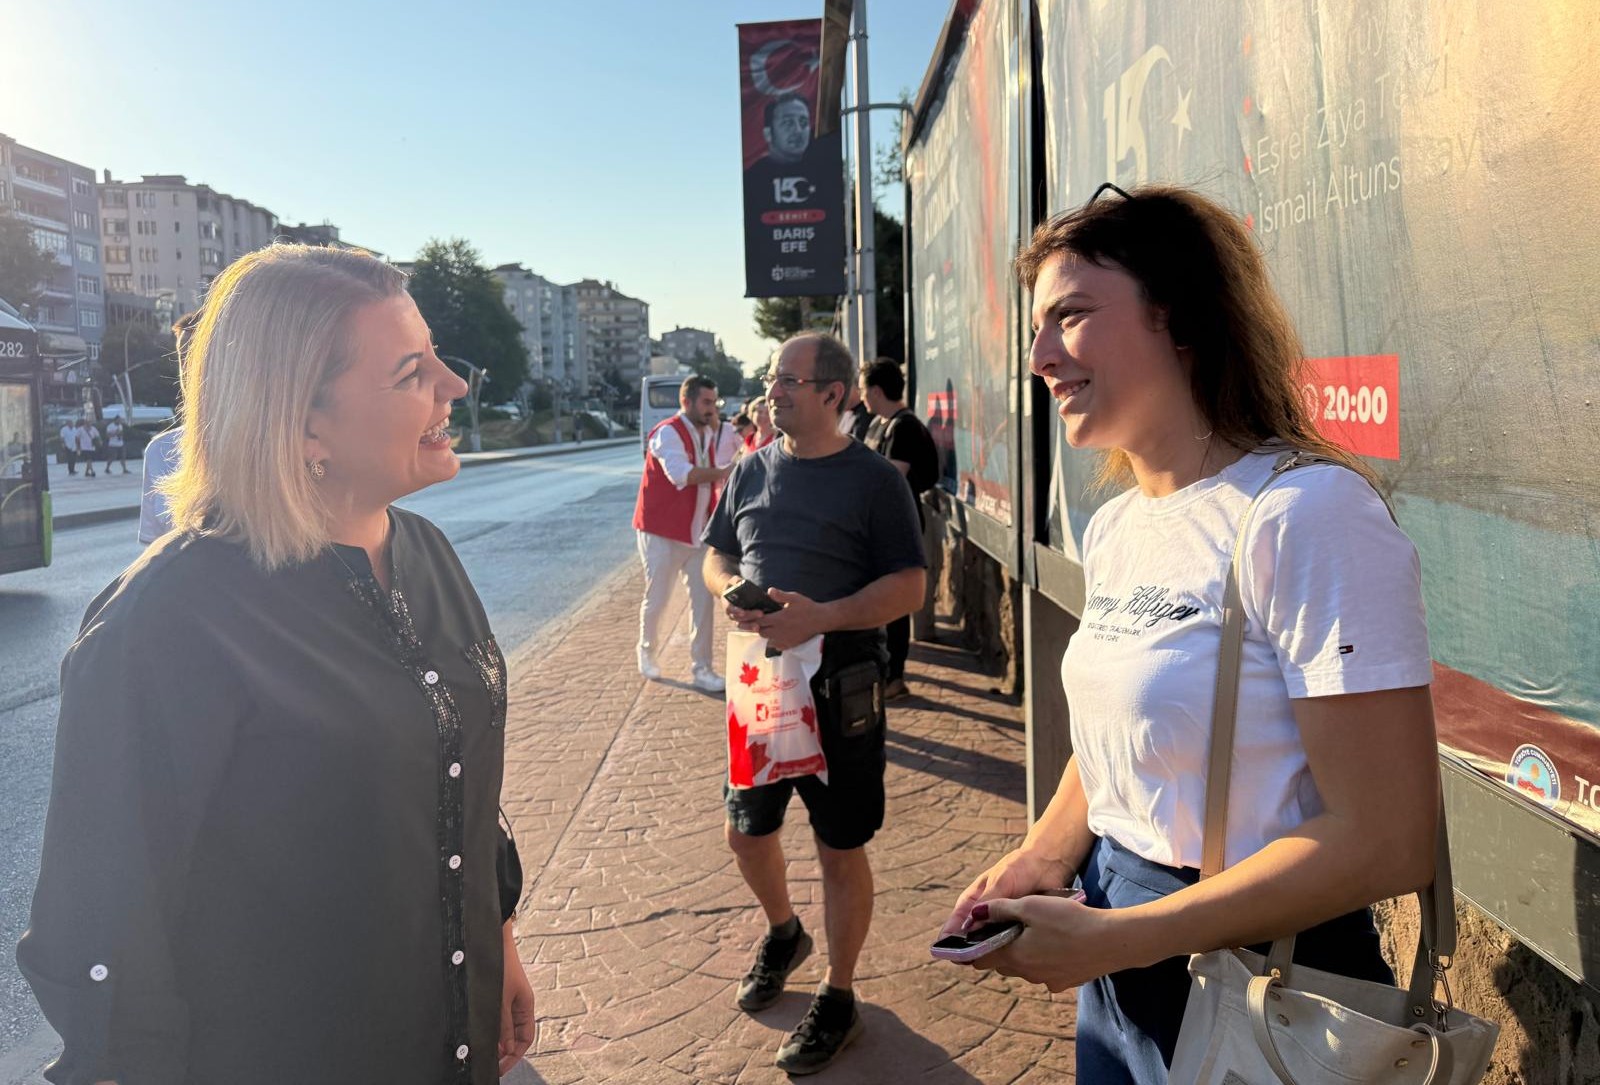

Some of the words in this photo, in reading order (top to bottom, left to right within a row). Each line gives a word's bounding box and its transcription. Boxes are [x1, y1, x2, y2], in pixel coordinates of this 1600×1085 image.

[1257, 176, 1317, 235] İsmail
[773, 226, 815, 241] BARIŞ
[781, 241, 808, 253] EFE
[1323, 384, 1388, 425] 20:00
[1120, 586, 1201, 628] Hilfiger
